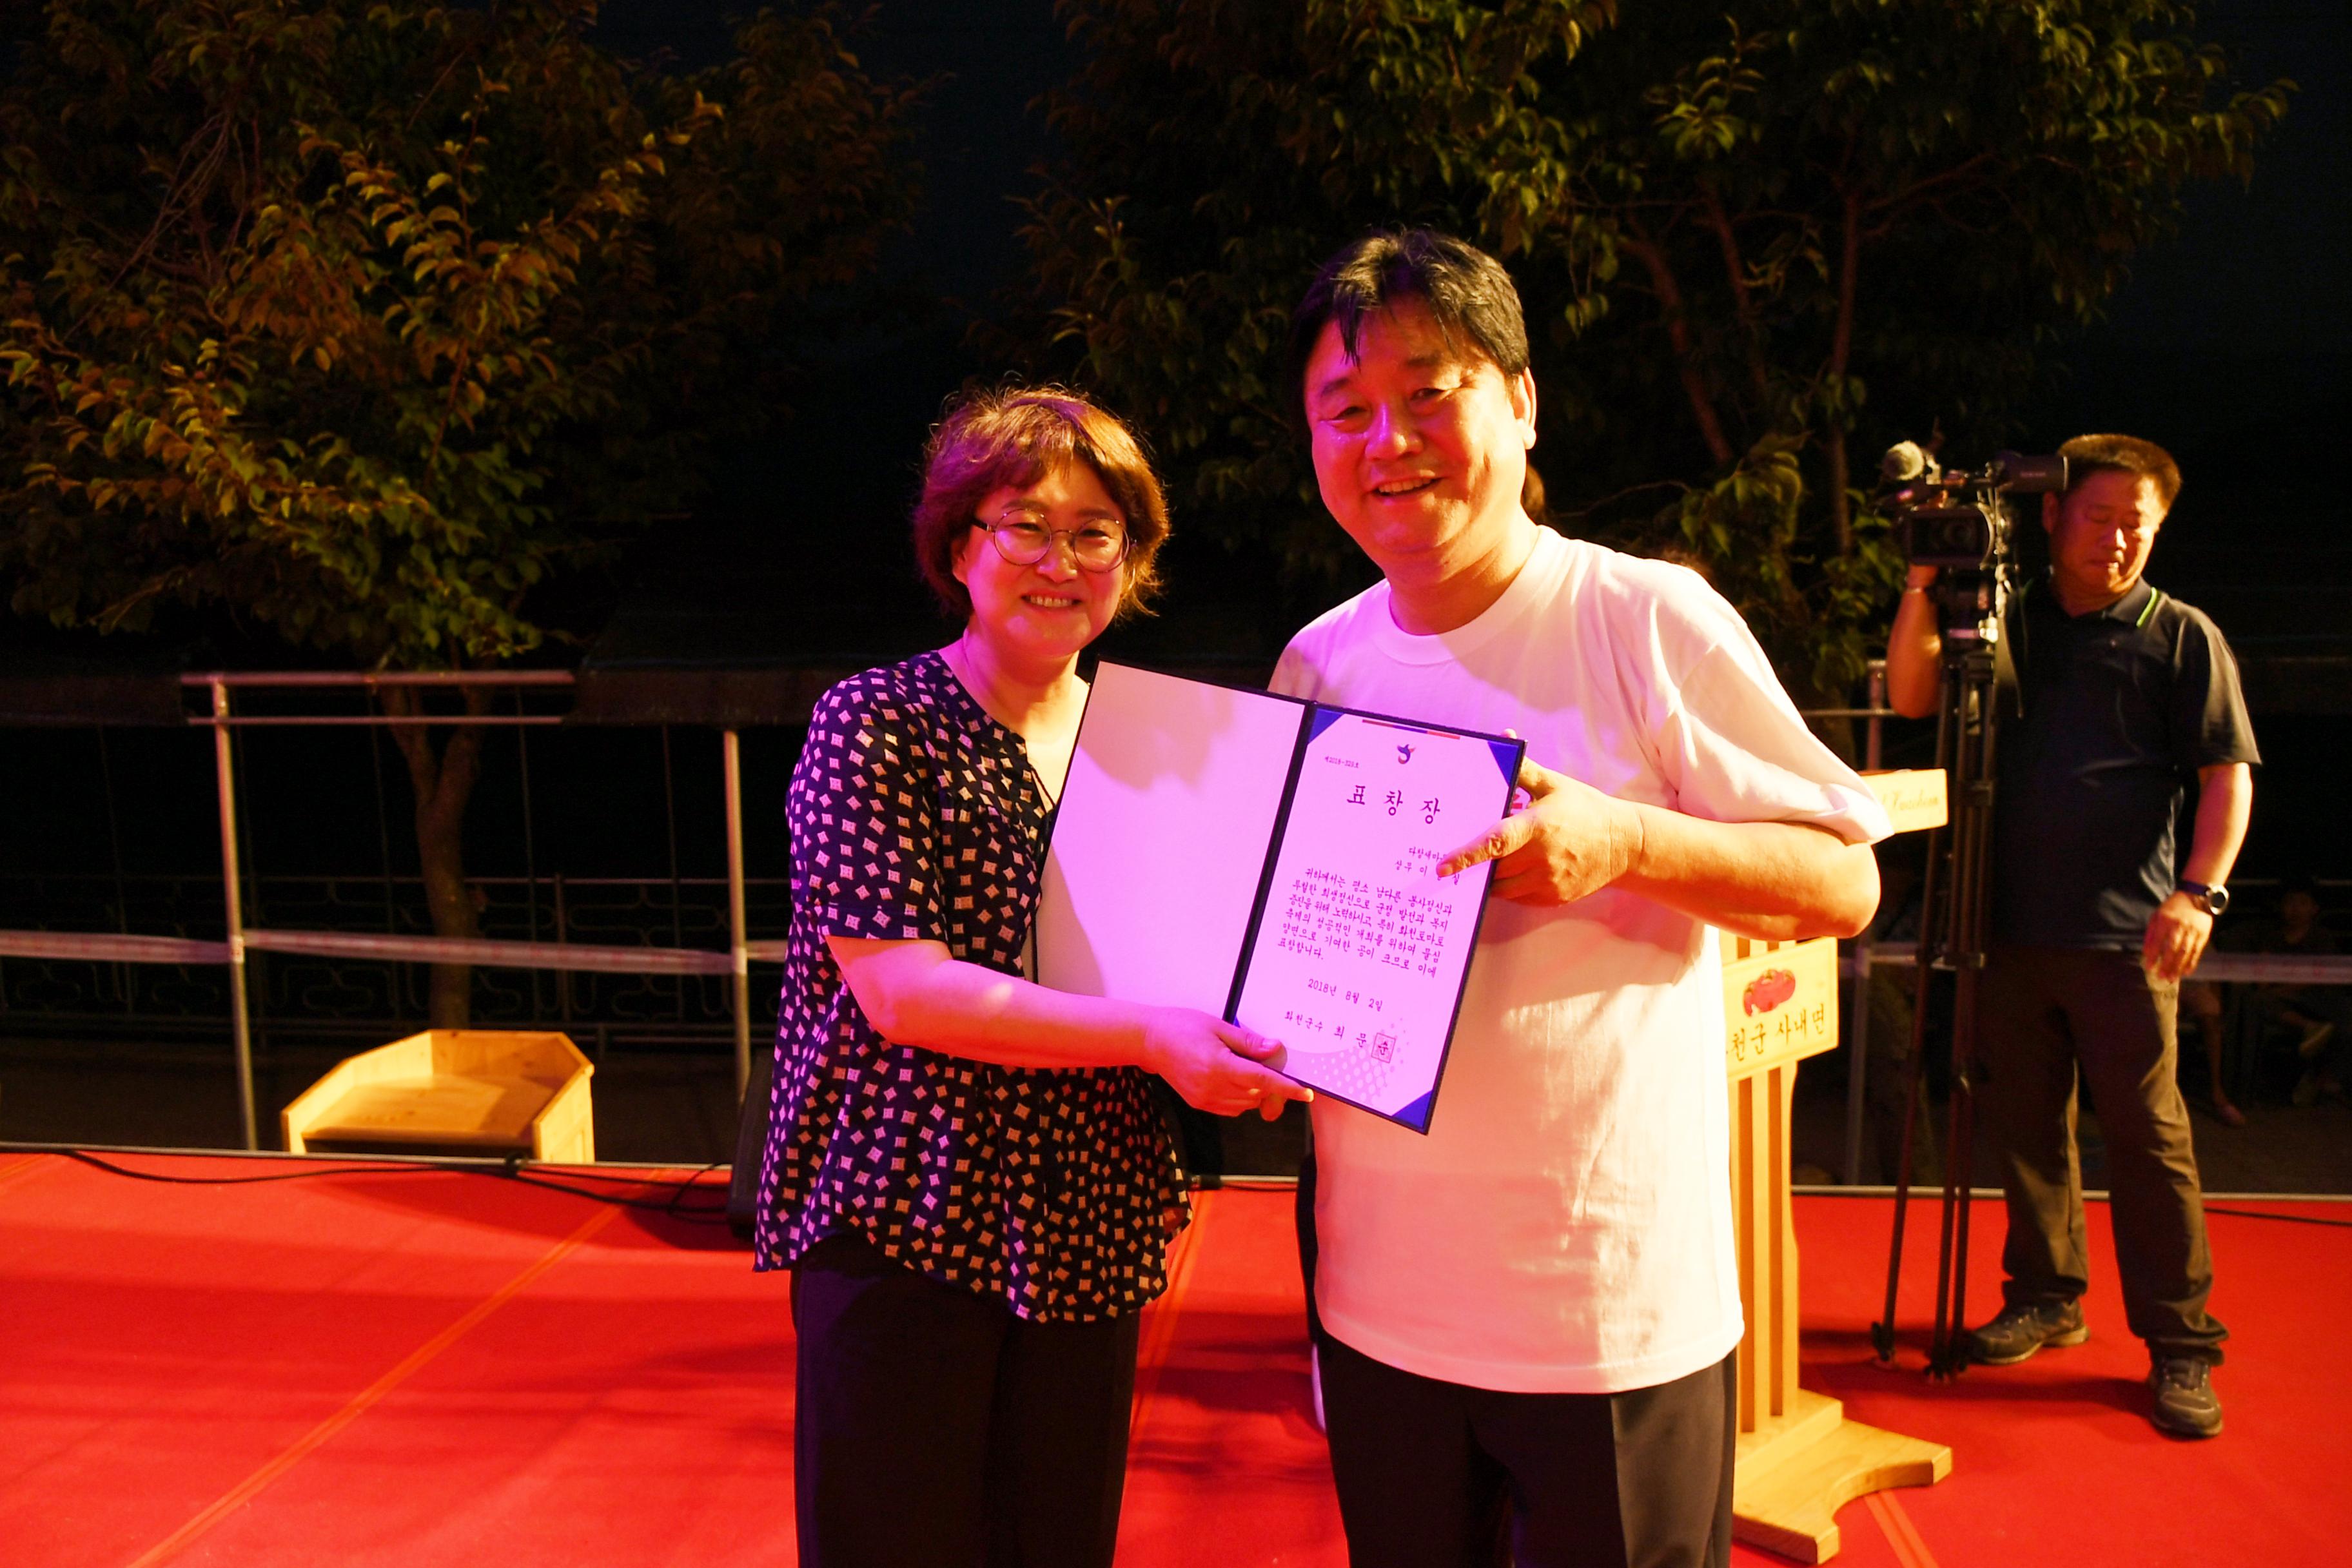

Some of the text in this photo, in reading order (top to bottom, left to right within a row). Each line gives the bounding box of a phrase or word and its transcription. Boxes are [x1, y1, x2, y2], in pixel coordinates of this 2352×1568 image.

[1305, 867, 1452, 916] 귀하께서는 평소 남다른 봉사정신과
[1321, 887, 1370, 910] 희생정신으로
[1399, 908, 1424, 925] 발전과
[1429, 917, 1448, 932] 복지
[1289, 894, 1311, 910] 증진을
[1314, 901, 1330, 914] 위해
[1377, 919, 1395, 933] 특히
[1398, 925, 1444, 947] 화천토마토
[1317, 917, 1351, 937] 성공적인
[1388, 938, 1416, 956] 위하여
[1422, 948, 1441, 963] 물심
[1278, 937, 1324, 960] 표창합니다.
[1283, 923, 1437, 979] 양면으로 기여한 공이 크므로 이에
[1308, 978, 1383, 1012] 2018년 8월 2일
[1726, 1003, 1825, 1062] 천군 사내면
